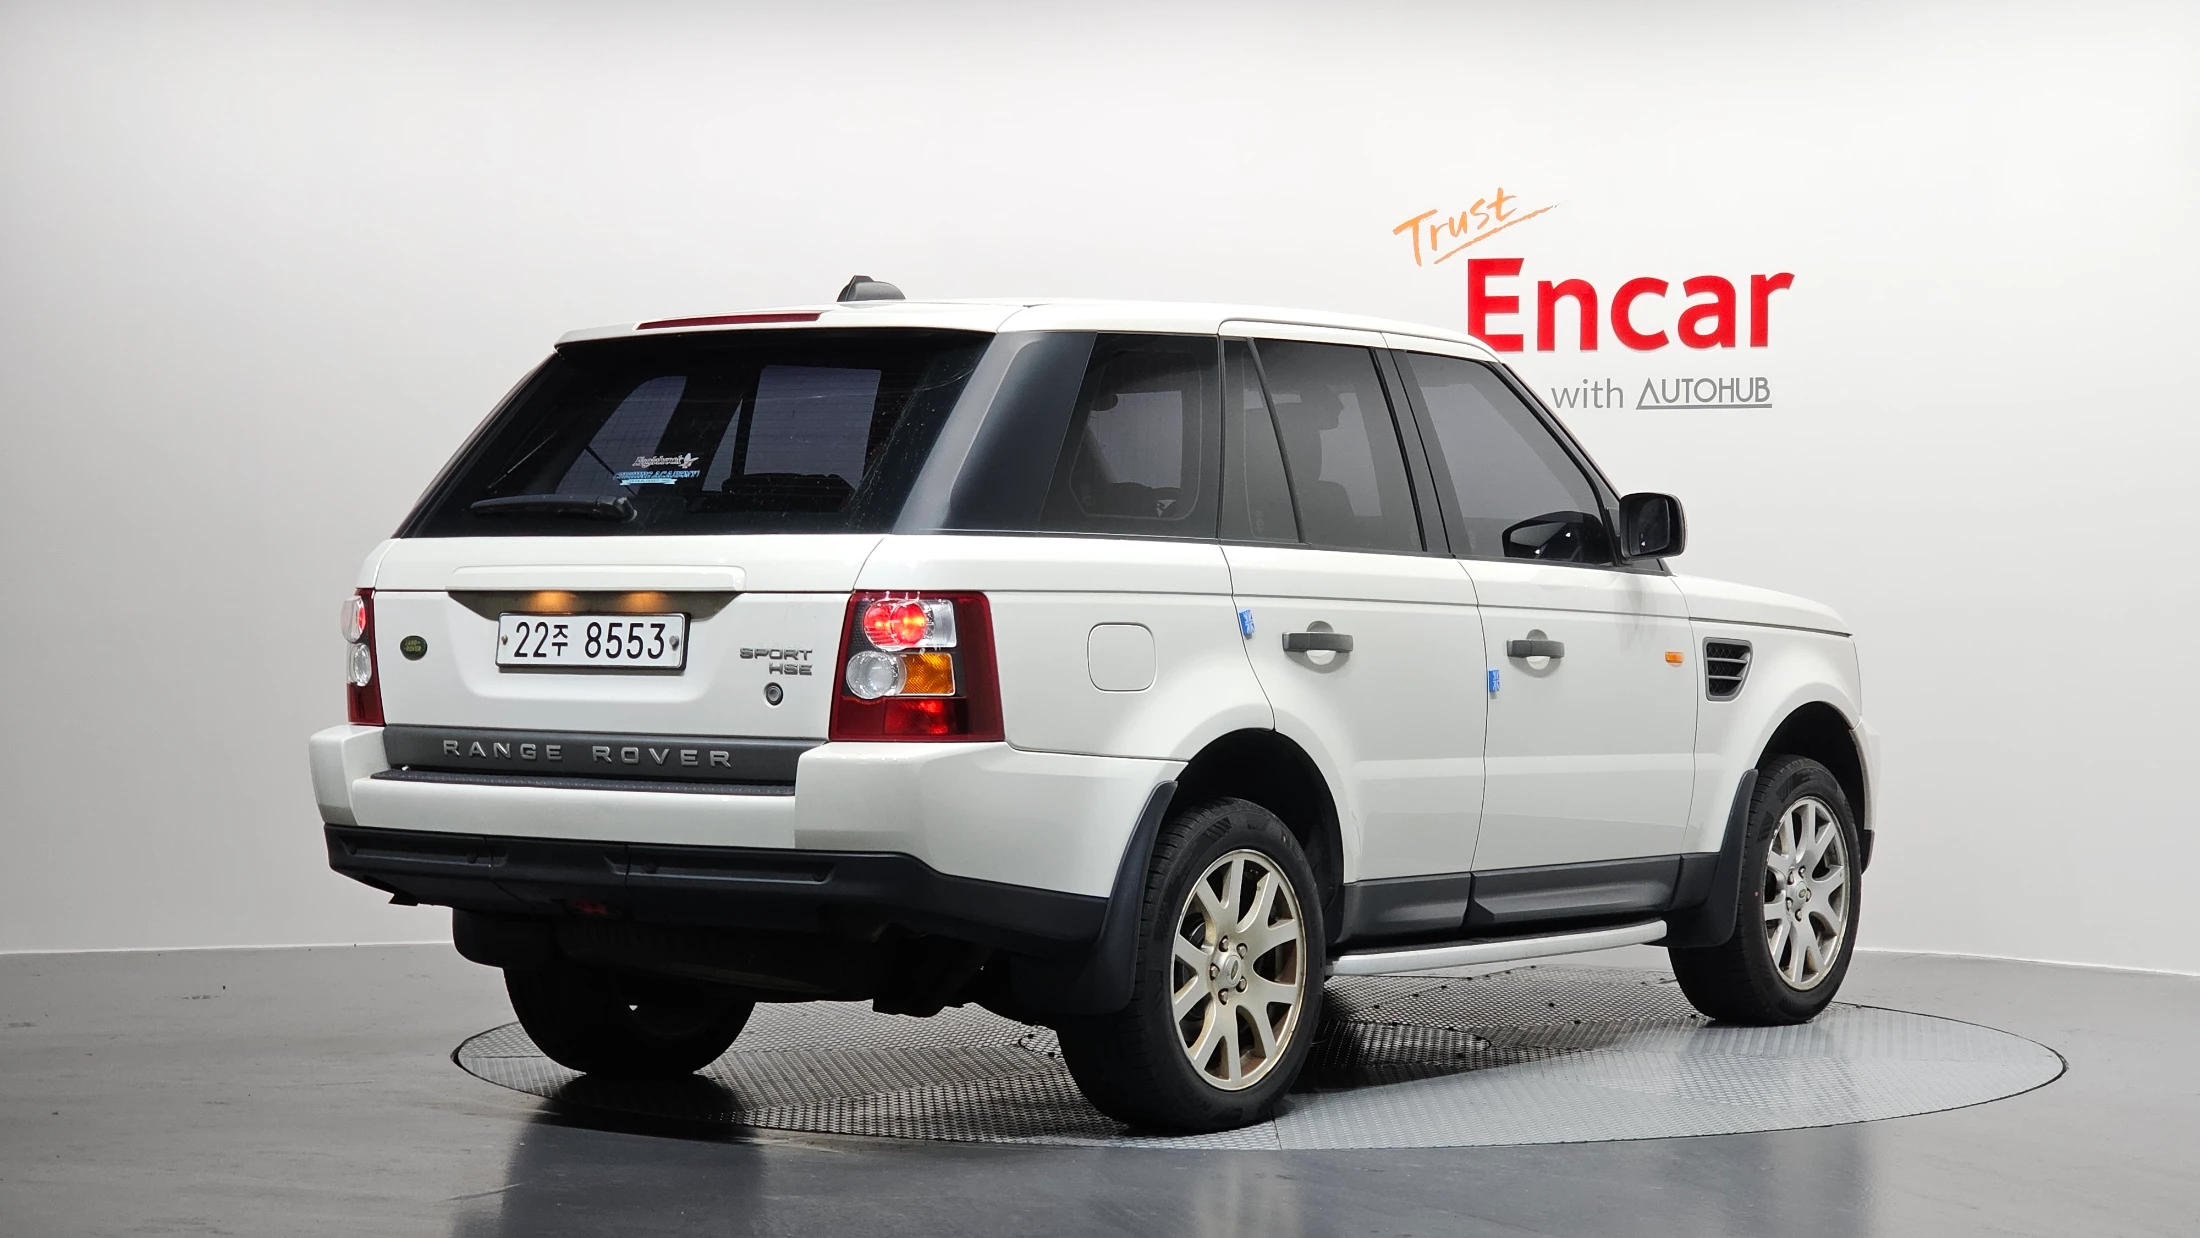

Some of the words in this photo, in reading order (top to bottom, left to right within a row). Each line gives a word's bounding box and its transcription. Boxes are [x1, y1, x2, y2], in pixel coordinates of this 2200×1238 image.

[1393, 187, 1517, 267] Trust
[1467, 257, 1795, 352] Encar
[1551, 378, 1624, 409] with
[1636, 377, 1772, 410] AUTOHUB
[513, 621, 568, 658] 22주
[585, 621, 666, 659] 8553
[739, 647, 812, 661] SPORT
[768, 662, 812, 676] HSE
[443, 739, 563, 761] RANGE
[592, 745, 732, 769] ROVER
